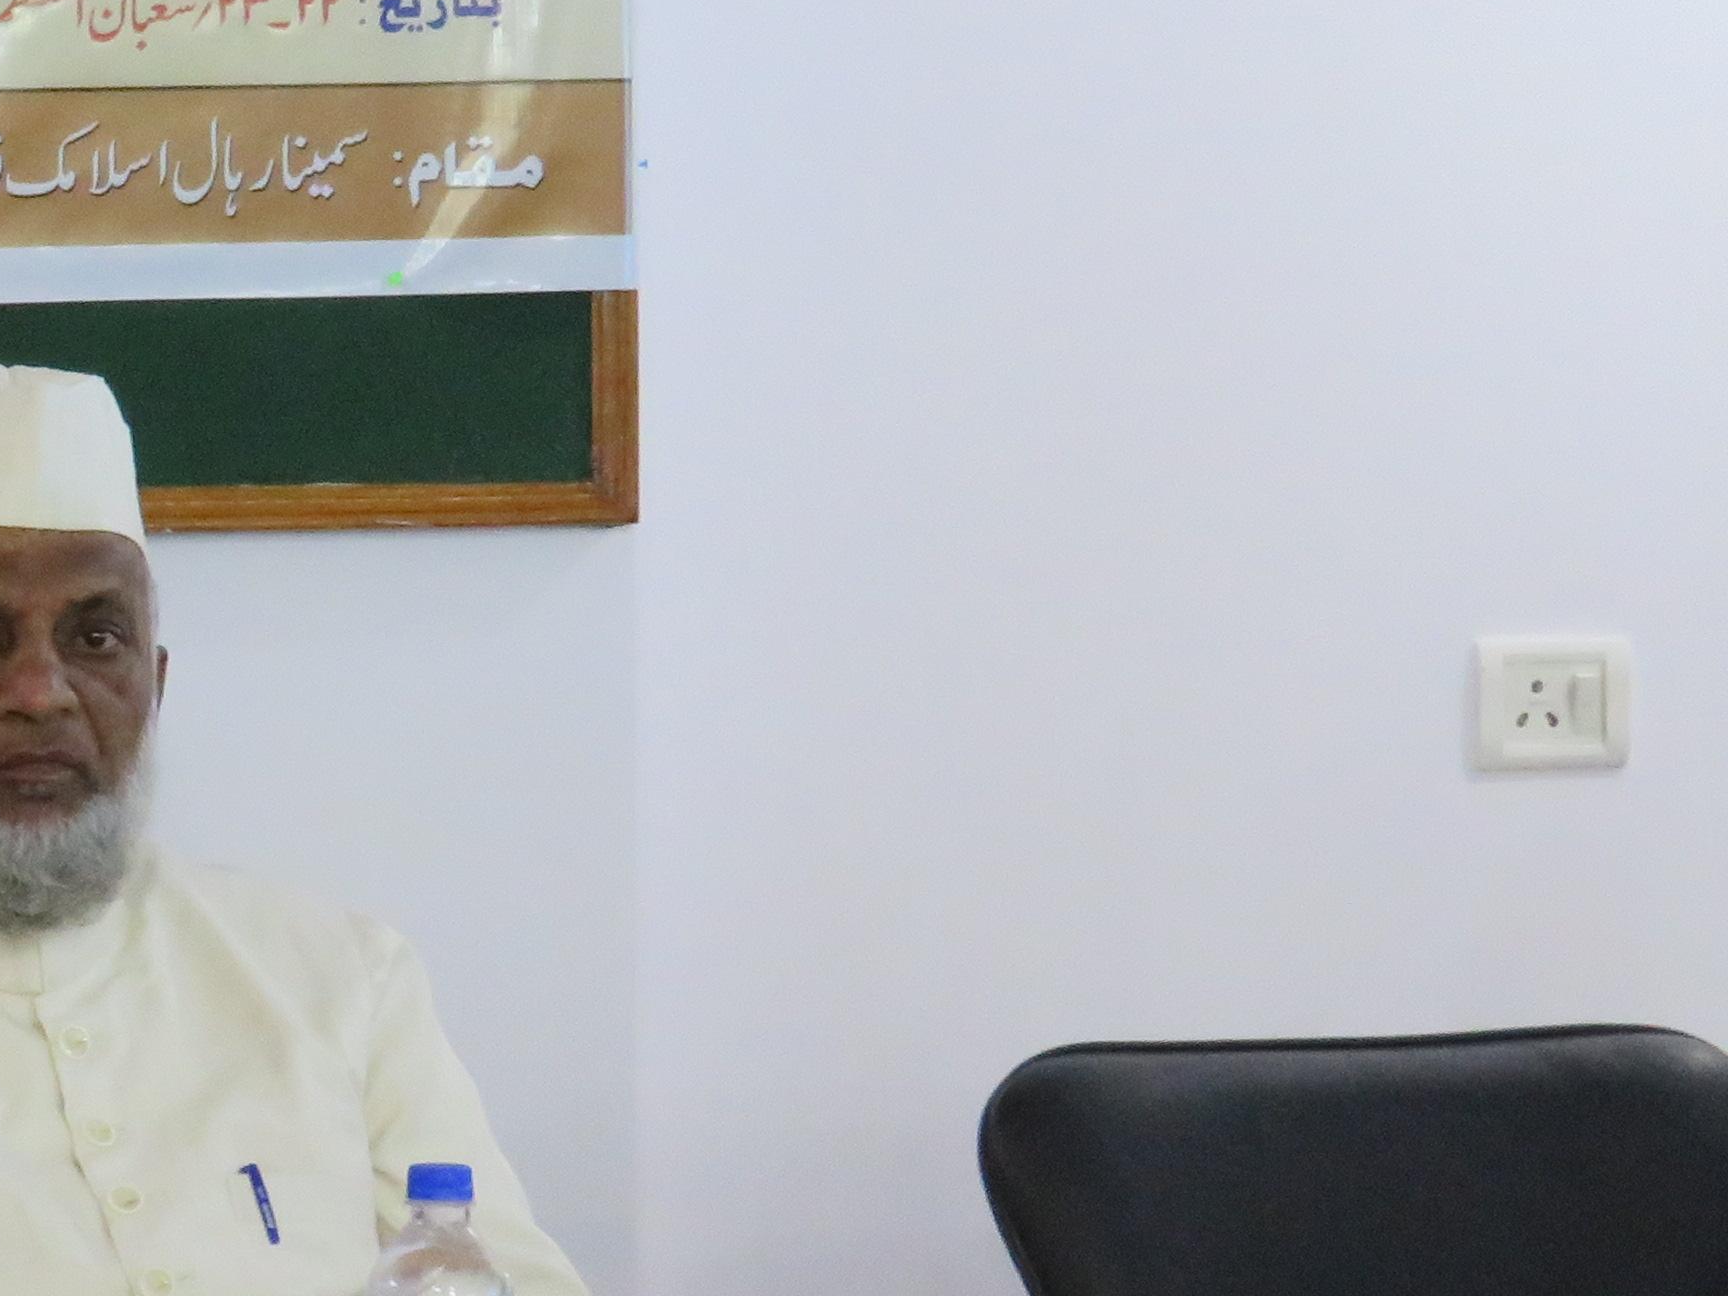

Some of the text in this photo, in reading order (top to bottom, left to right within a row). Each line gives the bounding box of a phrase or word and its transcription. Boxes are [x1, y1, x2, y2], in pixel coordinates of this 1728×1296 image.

[4, 120, 170, 197] اسلامک
[173, 115, 243, 218] ہال
[249, 130, 369, 200] سمینار
